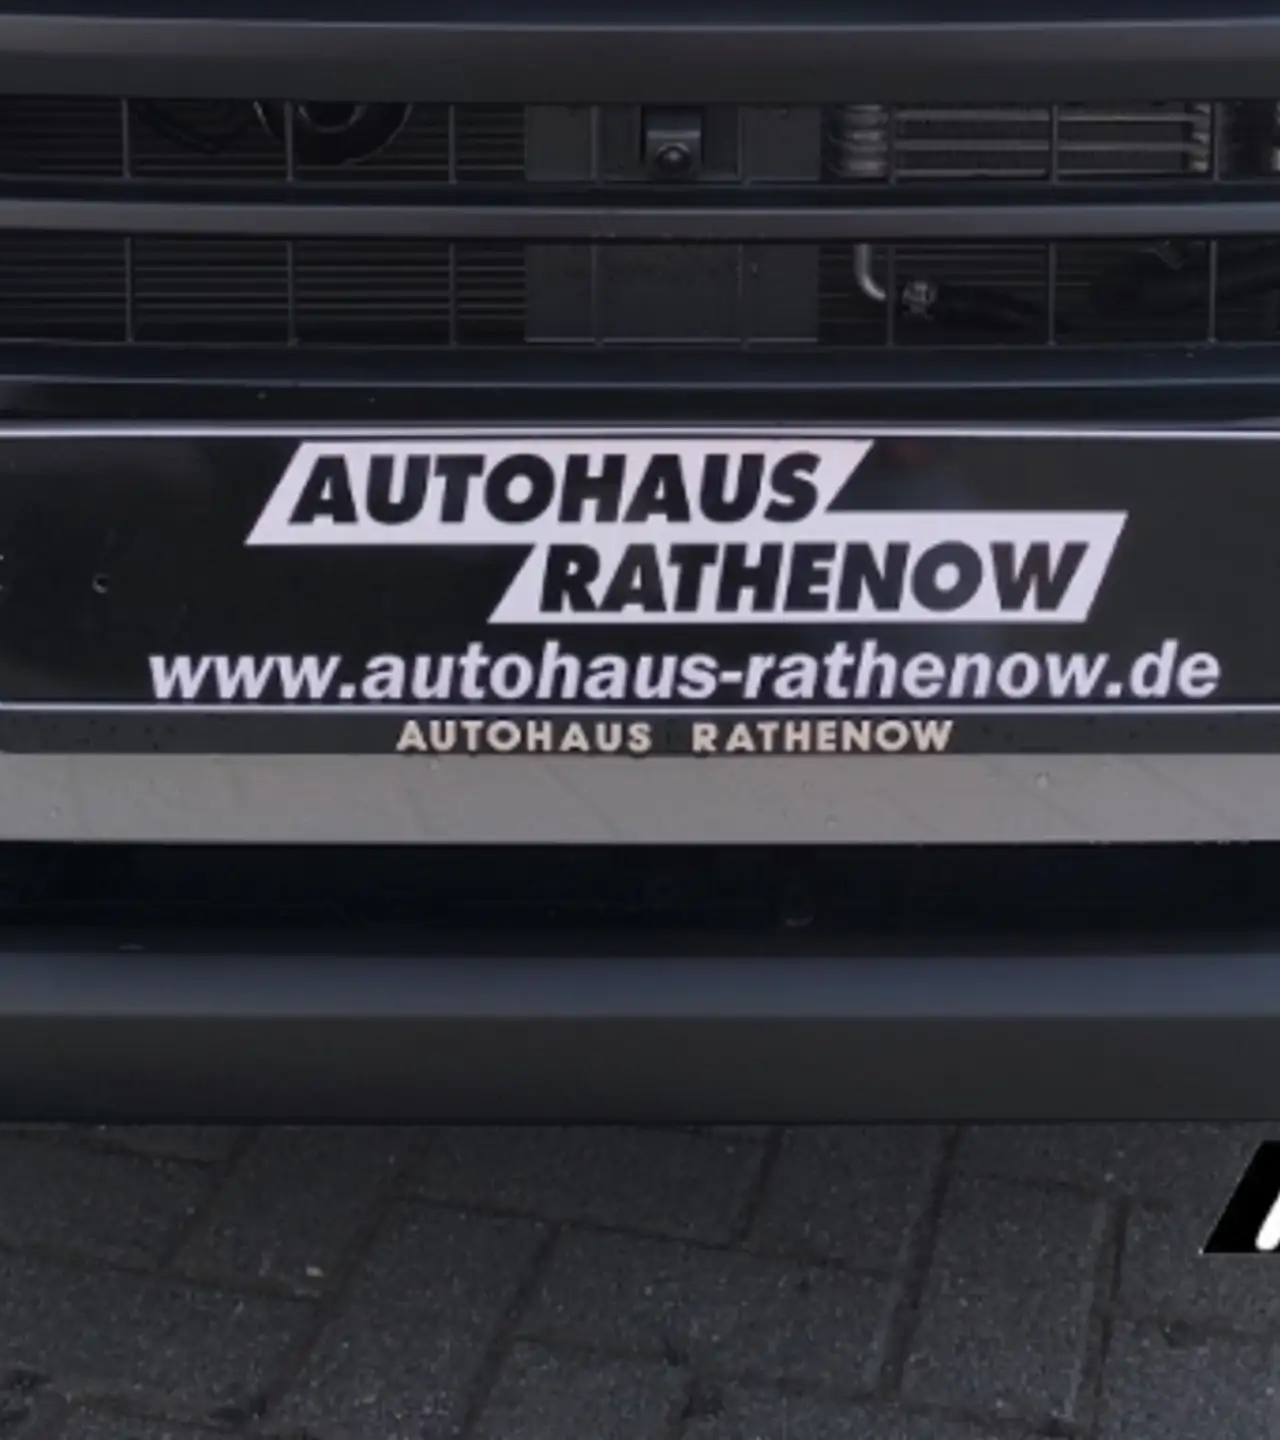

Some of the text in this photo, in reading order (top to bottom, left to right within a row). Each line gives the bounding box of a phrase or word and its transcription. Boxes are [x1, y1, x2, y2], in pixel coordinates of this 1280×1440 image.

[287, 451, 823, 525] AUTOHAUS
[539, 540, 1089, 613] RATHENOW
[148, 639, 1221, 699] www.autohaus-rathenow.de
[396, 719, 954, 752] AUTOHAUS RATHENOW
